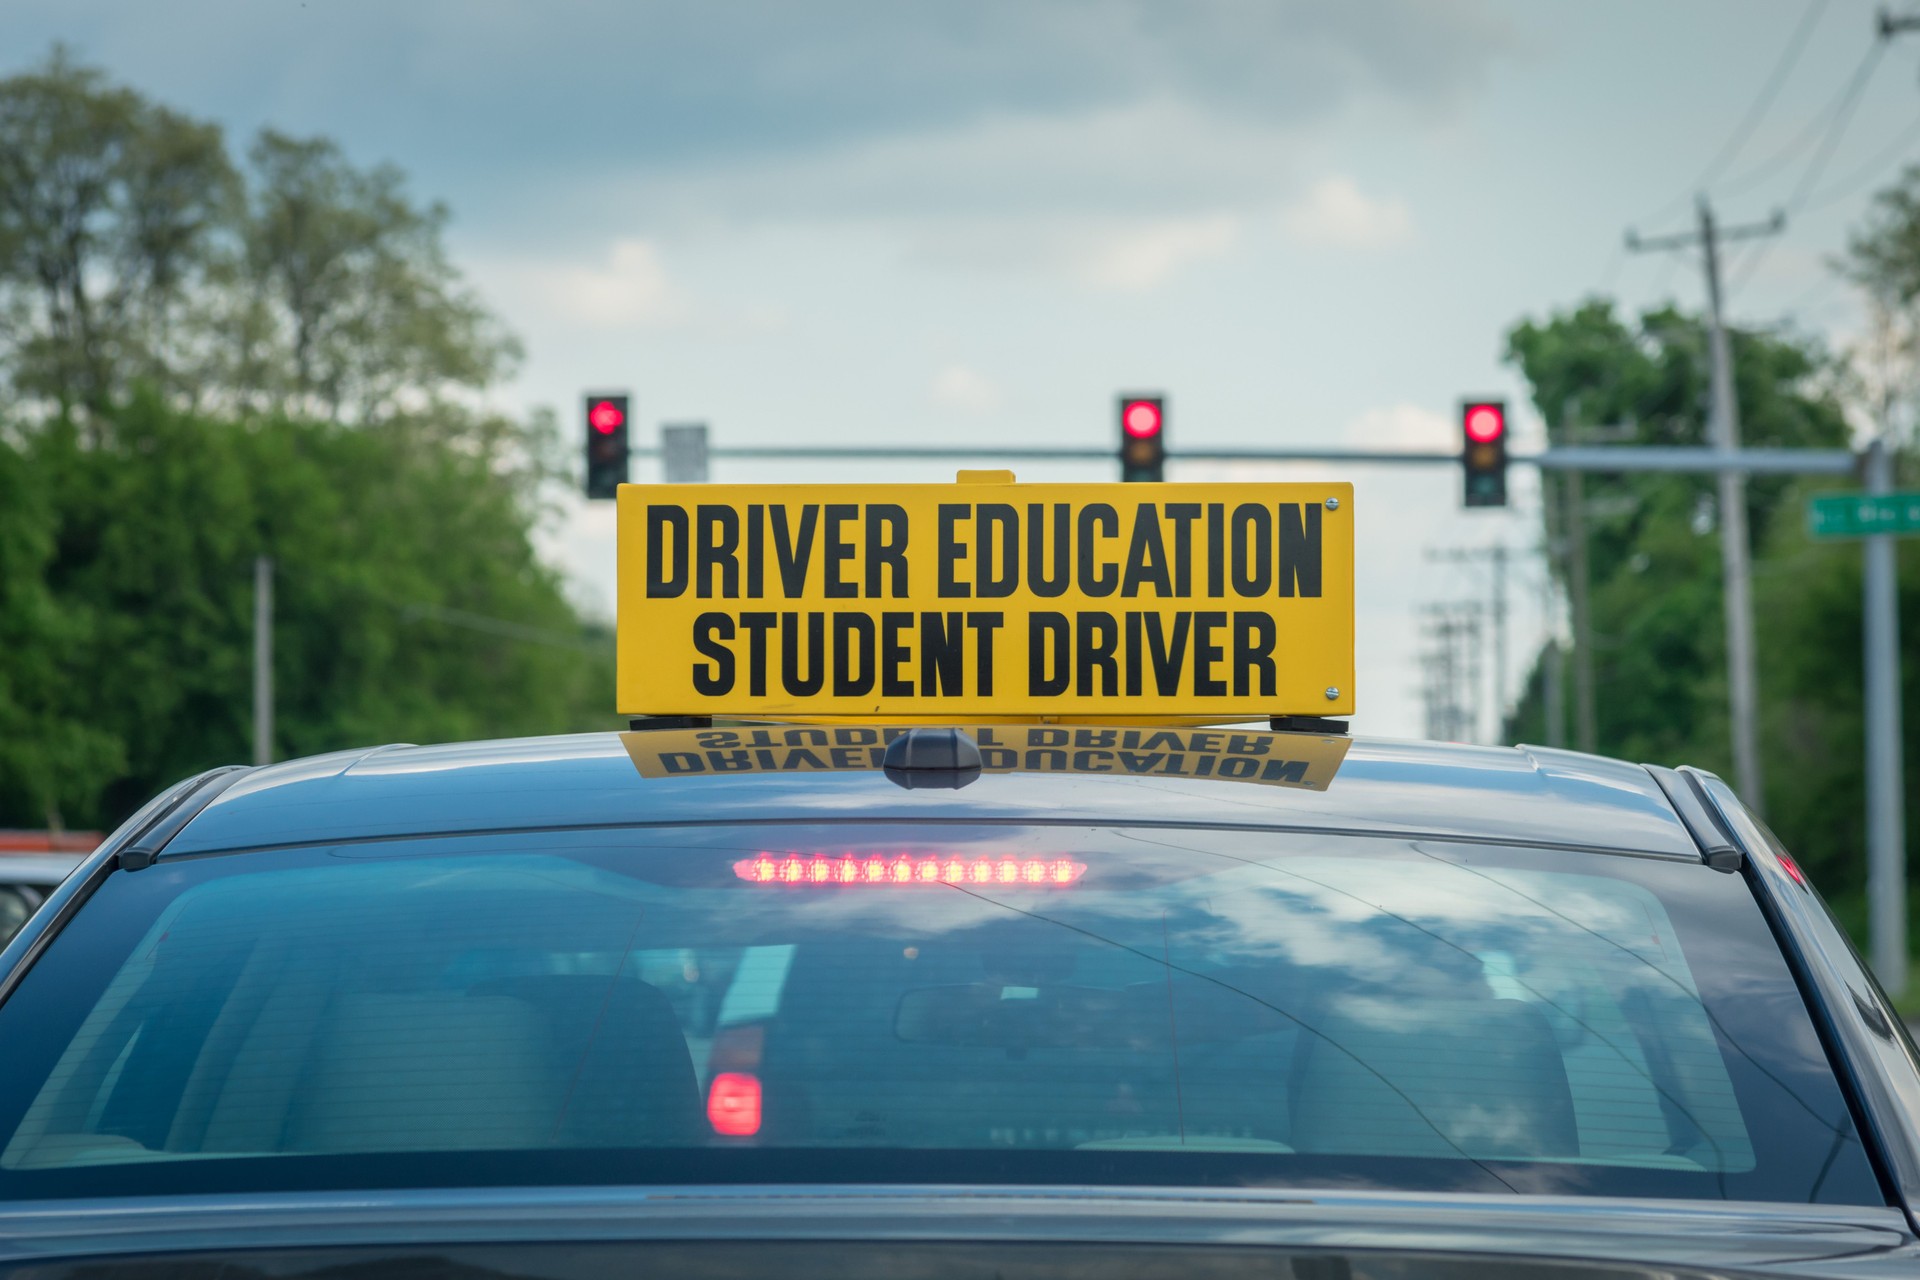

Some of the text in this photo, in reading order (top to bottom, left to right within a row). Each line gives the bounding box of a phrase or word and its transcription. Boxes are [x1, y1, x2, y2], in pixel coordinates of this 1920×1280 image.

[646, 503, 1323, 599] DRIVER EDUCATION
[692, 611, 1278, 697] STUDENT DRIVER
